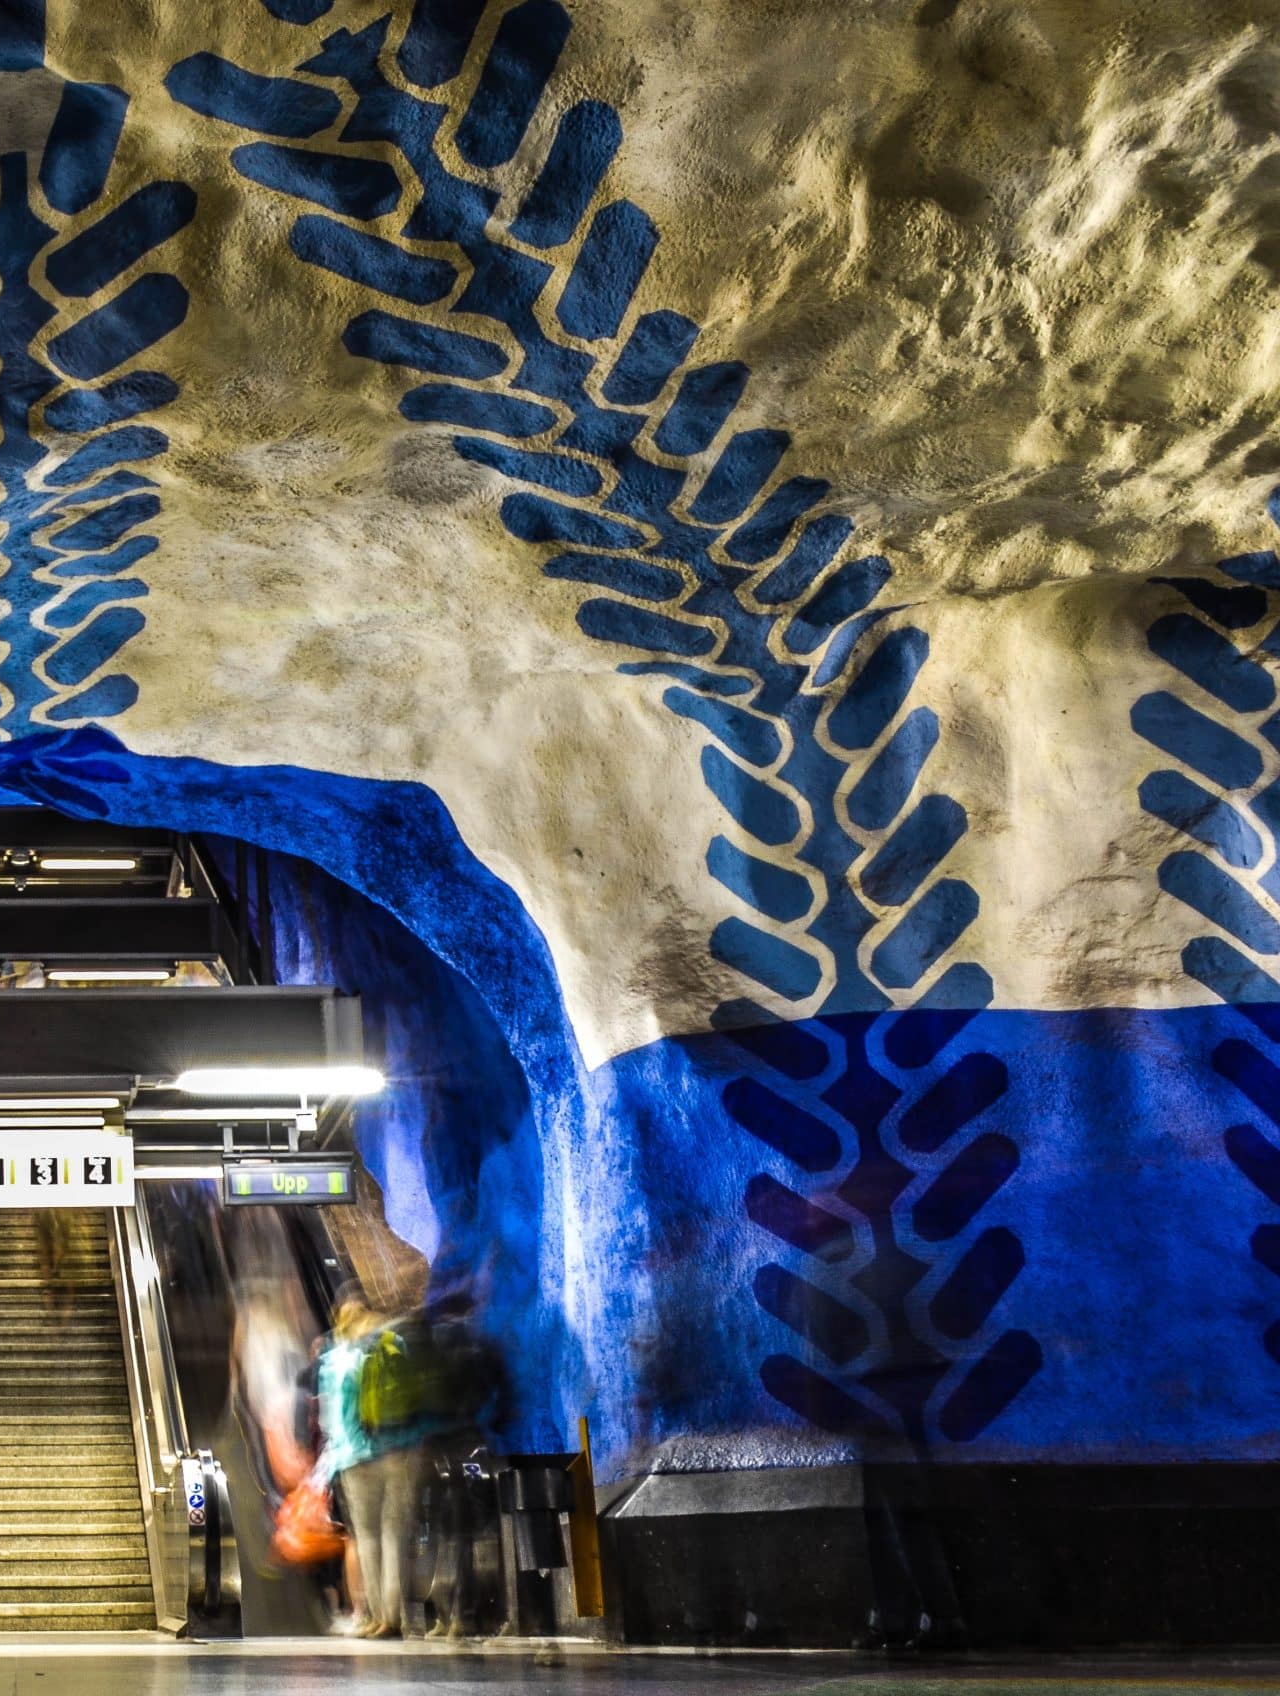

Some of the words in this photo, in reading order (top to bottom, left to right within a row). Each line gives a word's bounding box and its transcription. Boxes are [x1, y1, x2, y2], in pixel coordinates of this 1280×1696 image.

[37, 1165, 52, 1185] 3
[88, 1165, 105, 1184] 4
[272, 1172, 308, 1194] Upp
